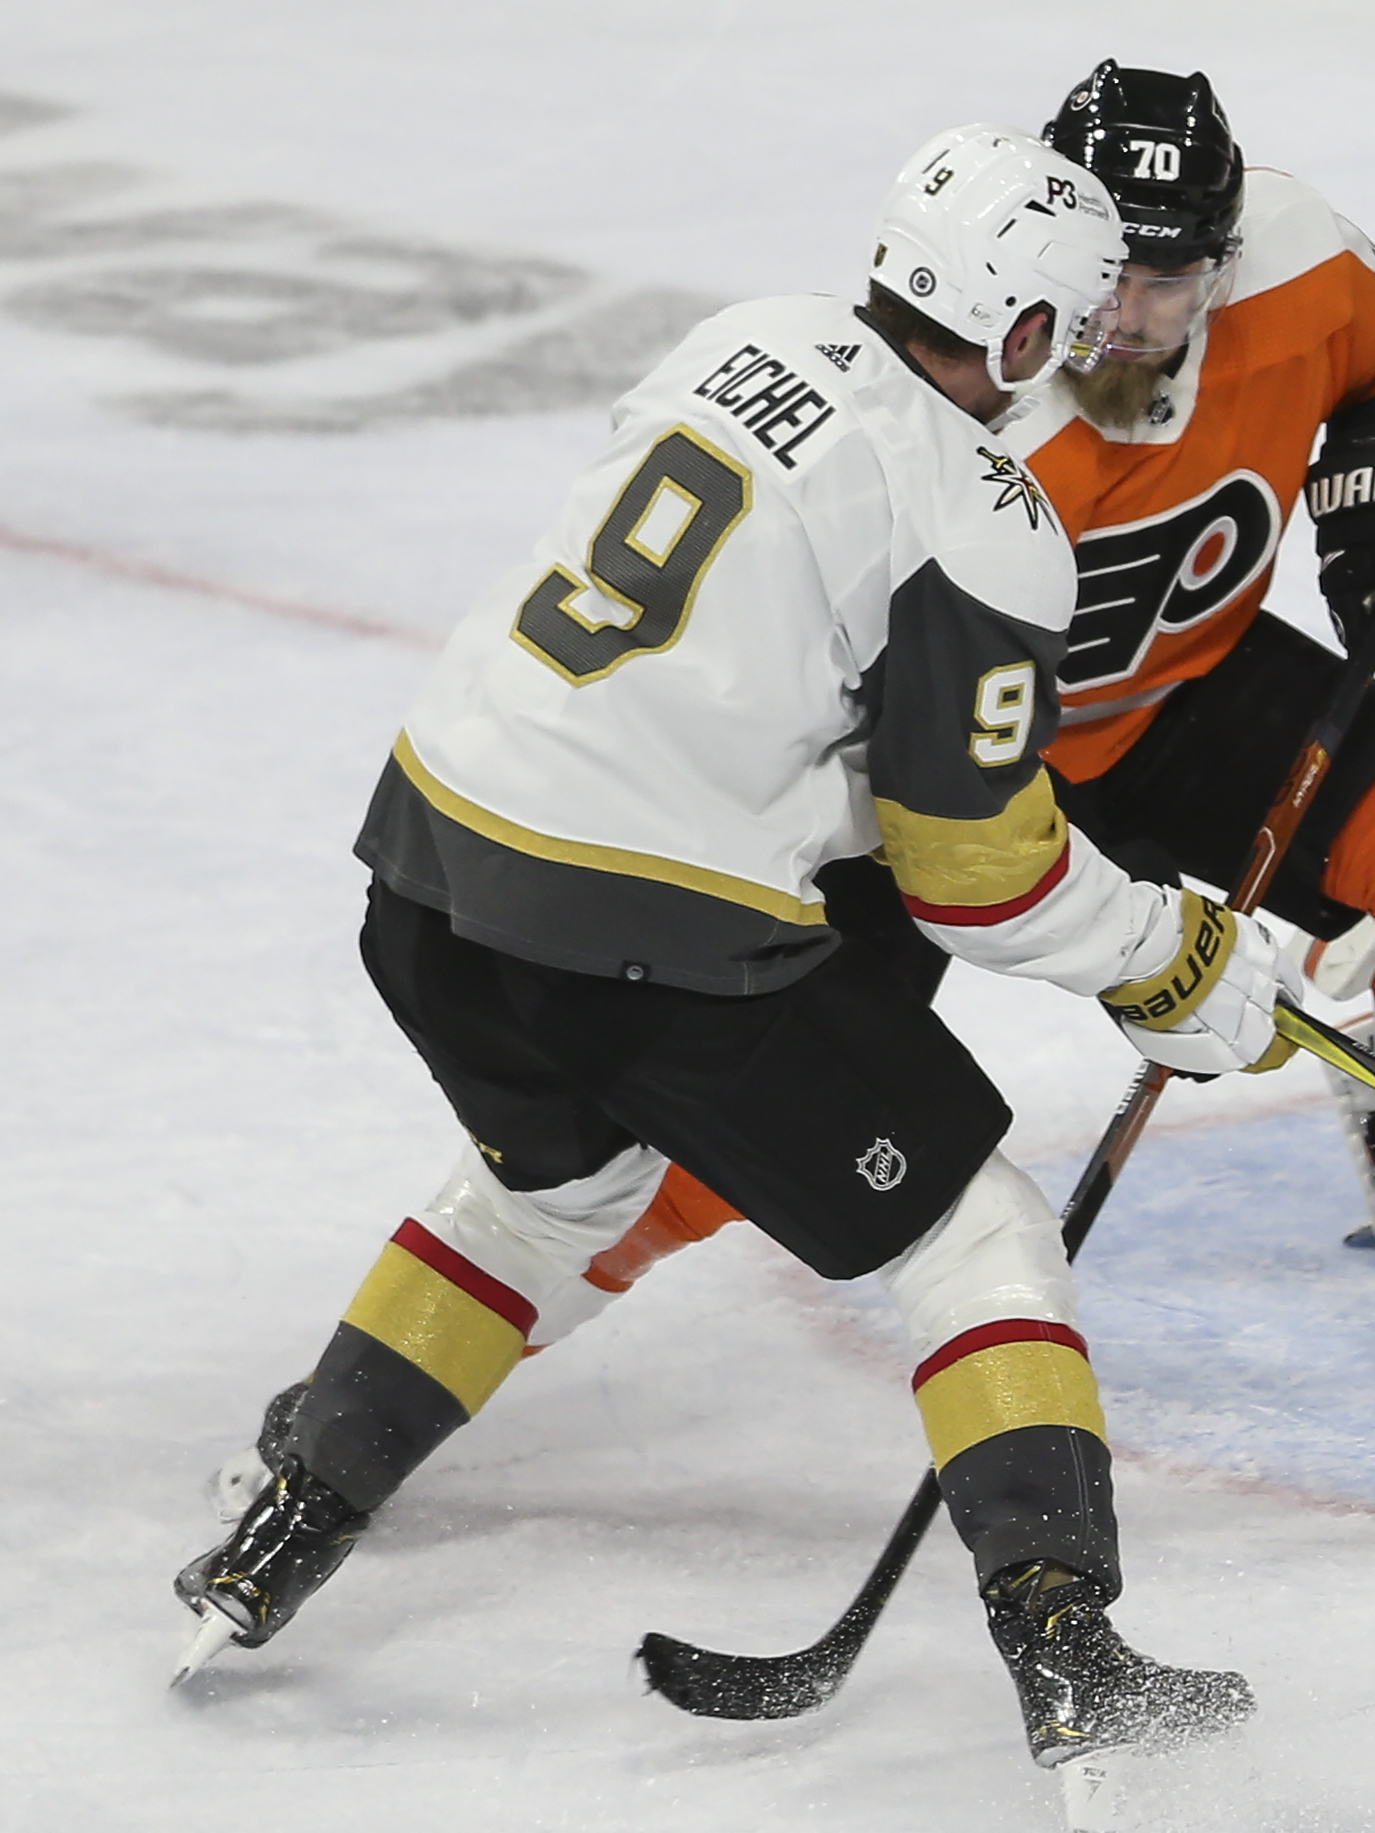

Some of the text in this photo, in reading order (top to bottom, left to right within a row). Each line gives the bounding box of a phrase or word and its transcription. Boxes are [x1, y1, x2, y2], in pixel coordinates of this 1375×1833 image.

[1129, 140, 1181, 181] 70
[924, 167, 955, 197] 9
[1046, 174, 1078, 210] P3
[1122, 222, 1182, 239] CCM
[692, 343, 837, 470] EICHEL
[509, 422, 753, 689] 9
[968, 659, 1037, 768] 9
